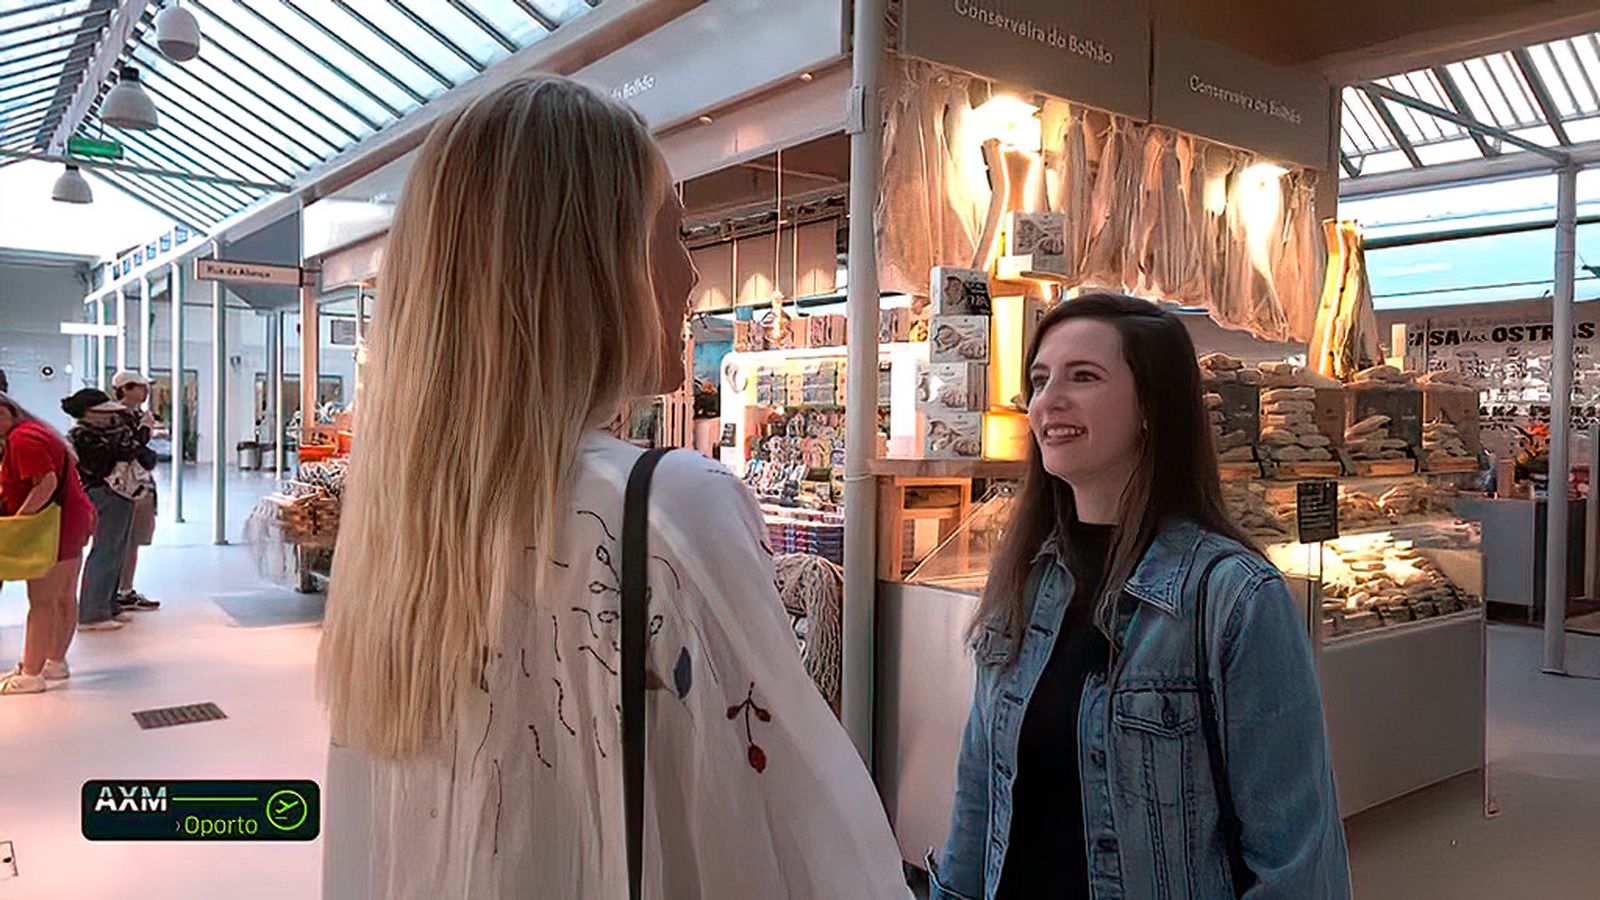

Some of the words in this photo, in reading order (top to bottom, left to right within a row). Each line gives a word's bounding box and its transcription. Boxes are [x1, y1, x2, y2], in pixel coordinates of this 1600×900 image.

[954, 0, 1044, 42] Conserveira
[1047, 26, 1066, 48] do
[1069, 35, 1113, 64] Bolhão
[1491, 322, 1595, 342] OSTRS
